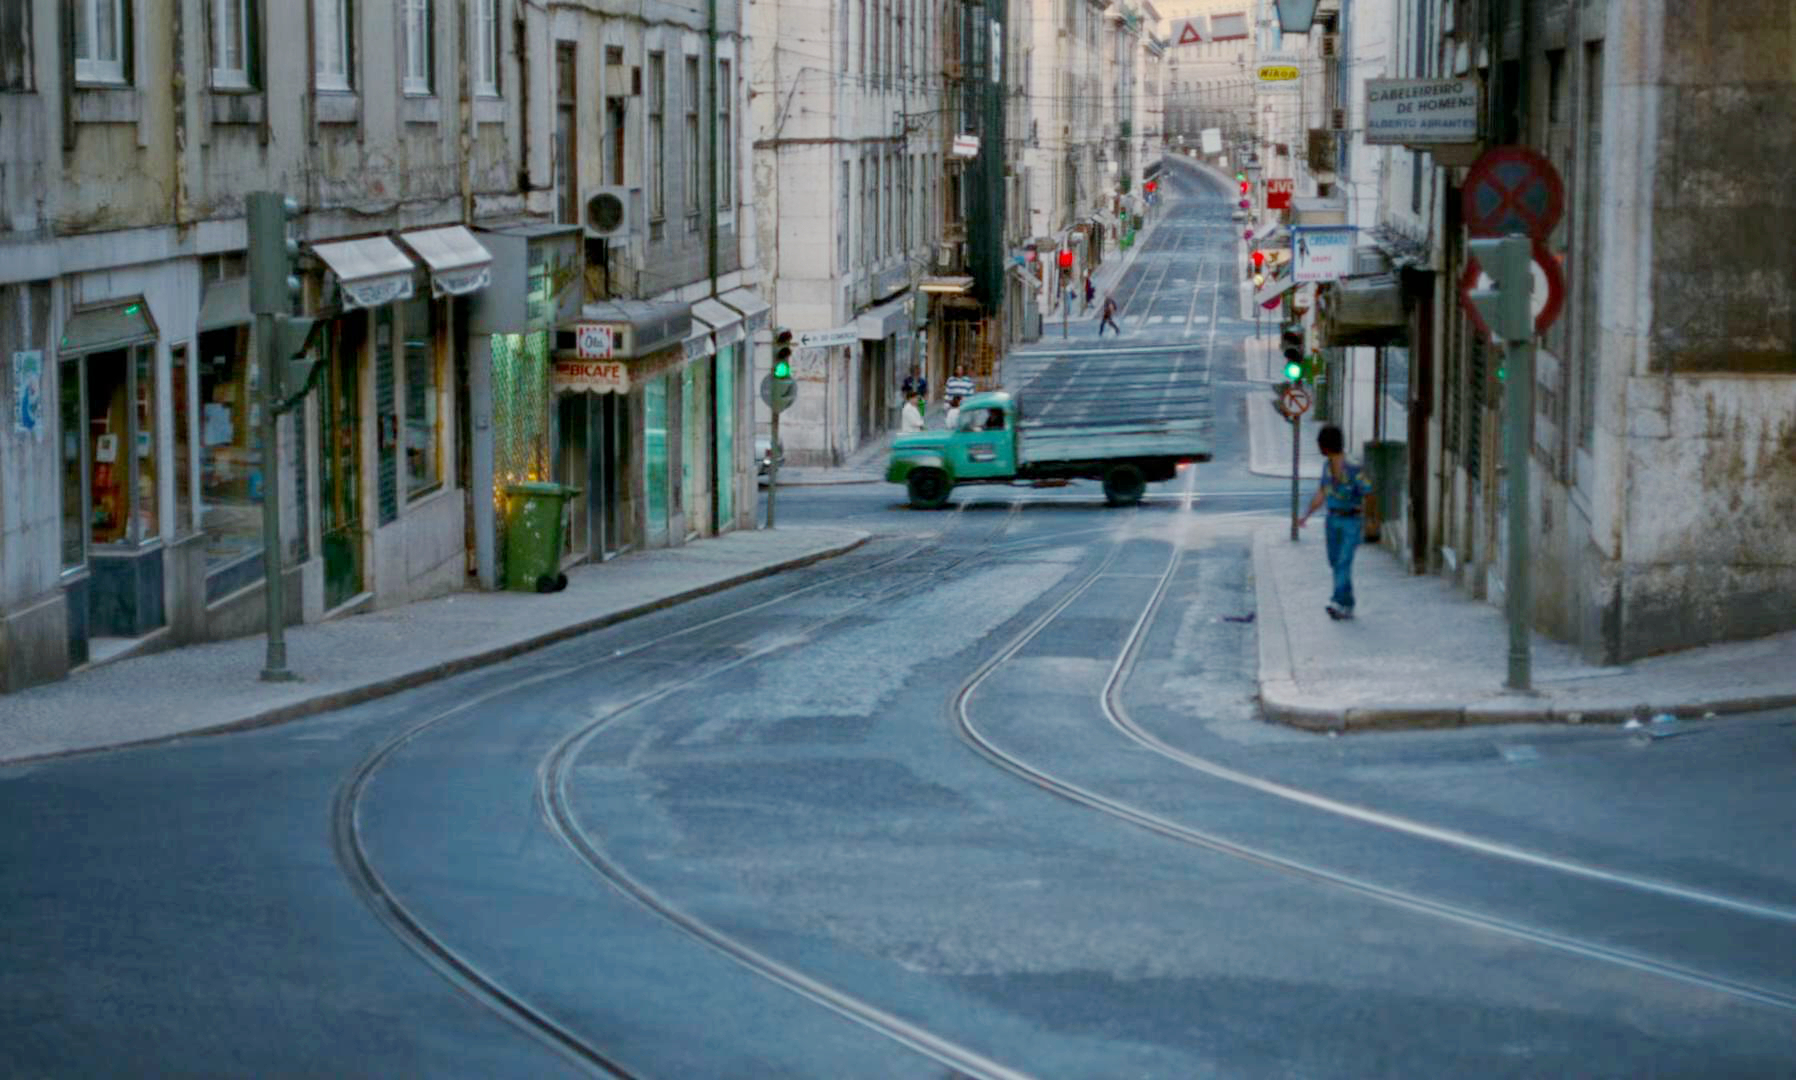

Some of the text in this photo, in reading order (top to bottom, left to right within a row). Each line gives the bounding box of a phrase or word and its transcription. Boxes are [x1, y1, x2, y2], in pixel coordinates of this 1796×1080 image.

[1260, 69, 1297, 78] Nikon
[1369, 82, 1464, 102] CABELEIREIRO
[1397, 97, 1474, 114] DE HOMENS
[1368, 119, 1416, 129] ALBERTO
[1269, 180, 1295, 193] JVC
